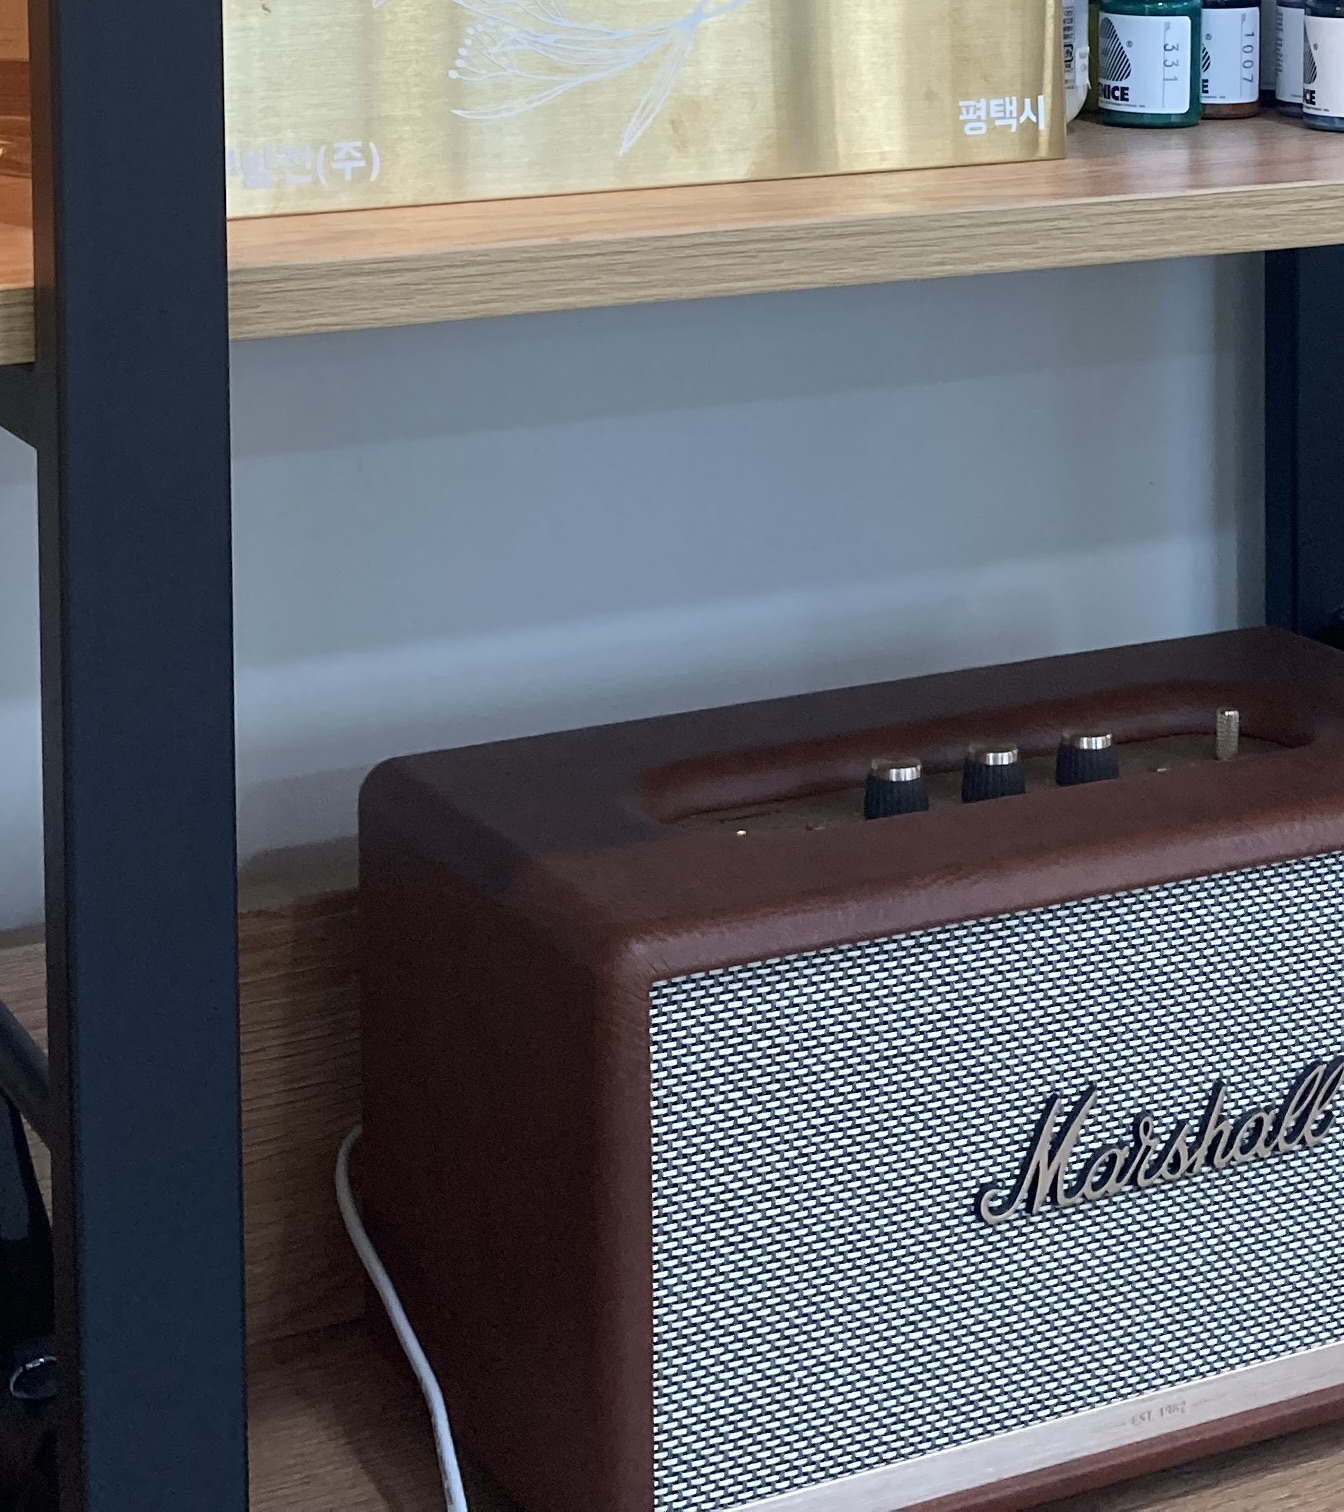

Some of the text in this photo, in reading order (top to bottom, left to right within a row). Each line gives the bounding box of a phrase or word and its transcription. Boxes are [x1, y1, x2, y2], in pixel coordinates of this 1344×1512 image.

[1163, 43, 1179, 82] 331
[1241, 31, 1255, 83] 1007
[959, 94, 1045, 136] 평택시
